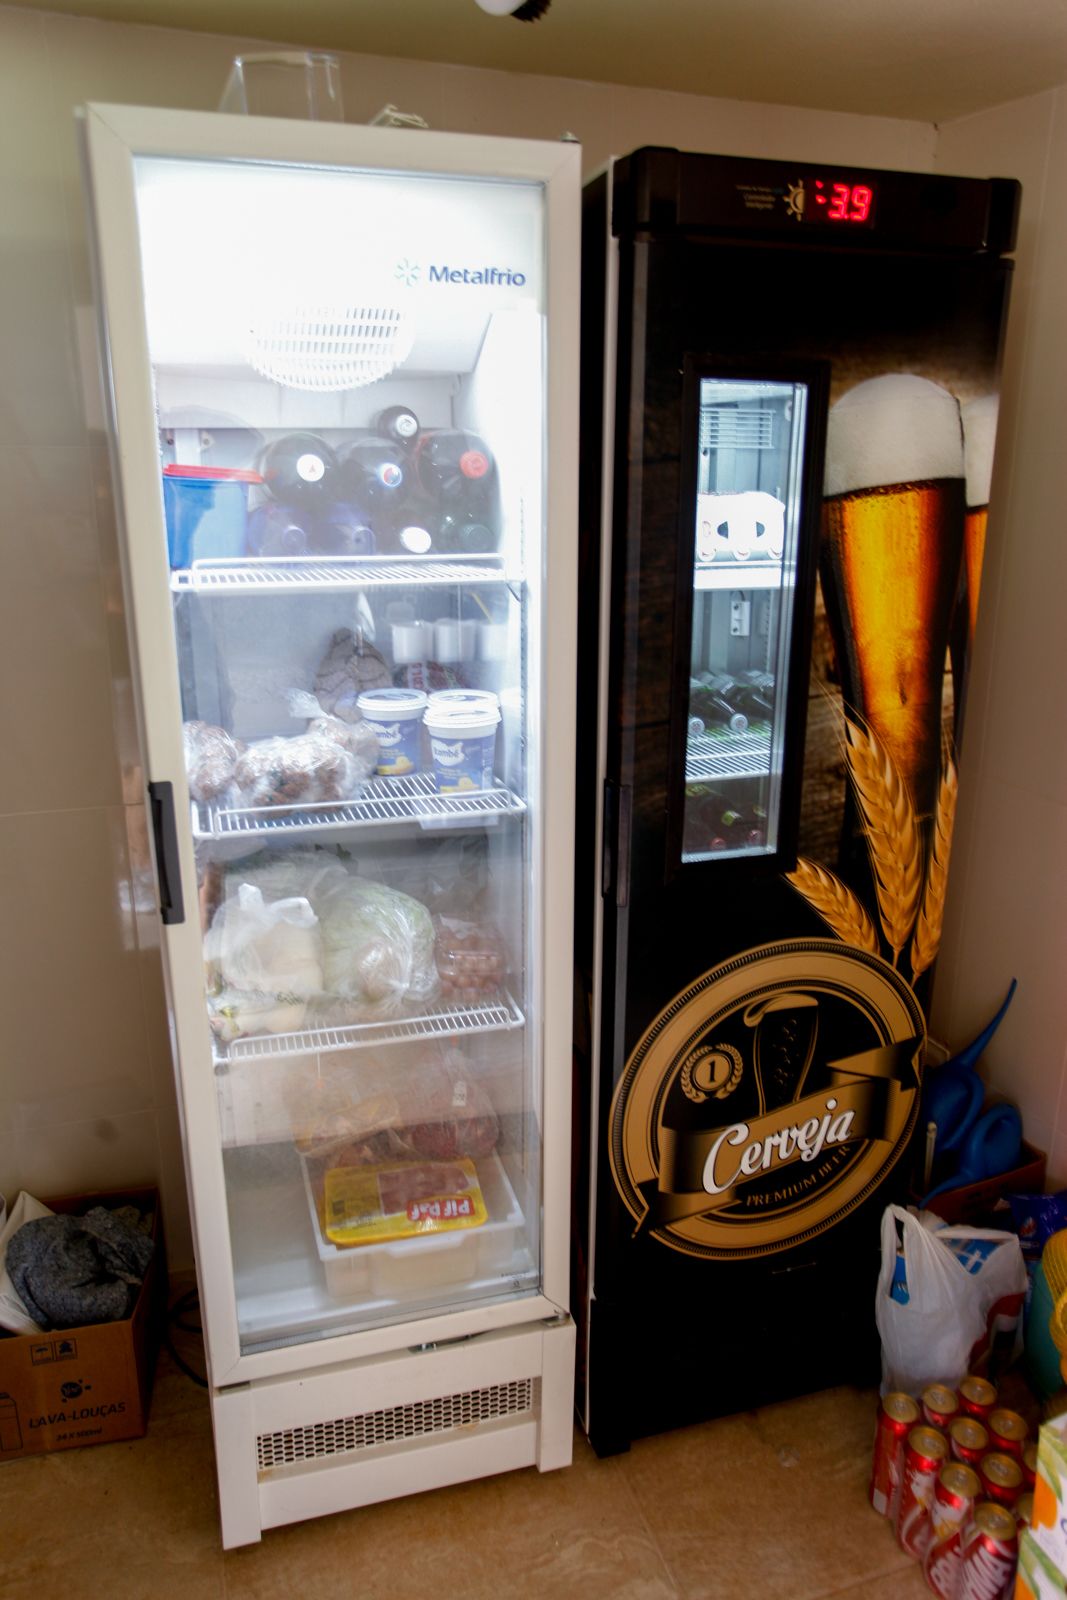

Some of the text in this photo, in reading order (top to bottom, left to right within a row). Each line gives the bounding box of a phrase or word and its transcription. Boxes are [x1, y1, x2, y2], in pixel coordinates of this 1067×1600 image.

[428, 265, 526, 286] Metalfrio
[708, 1060, 716, 1083] 1
[702, 1098, 855, 1194] Cerveja
[746, 1145, 850, 1207] PREMIUM BEER
[29, 1402, 126, 1429] LAVA-LOUÇAS
